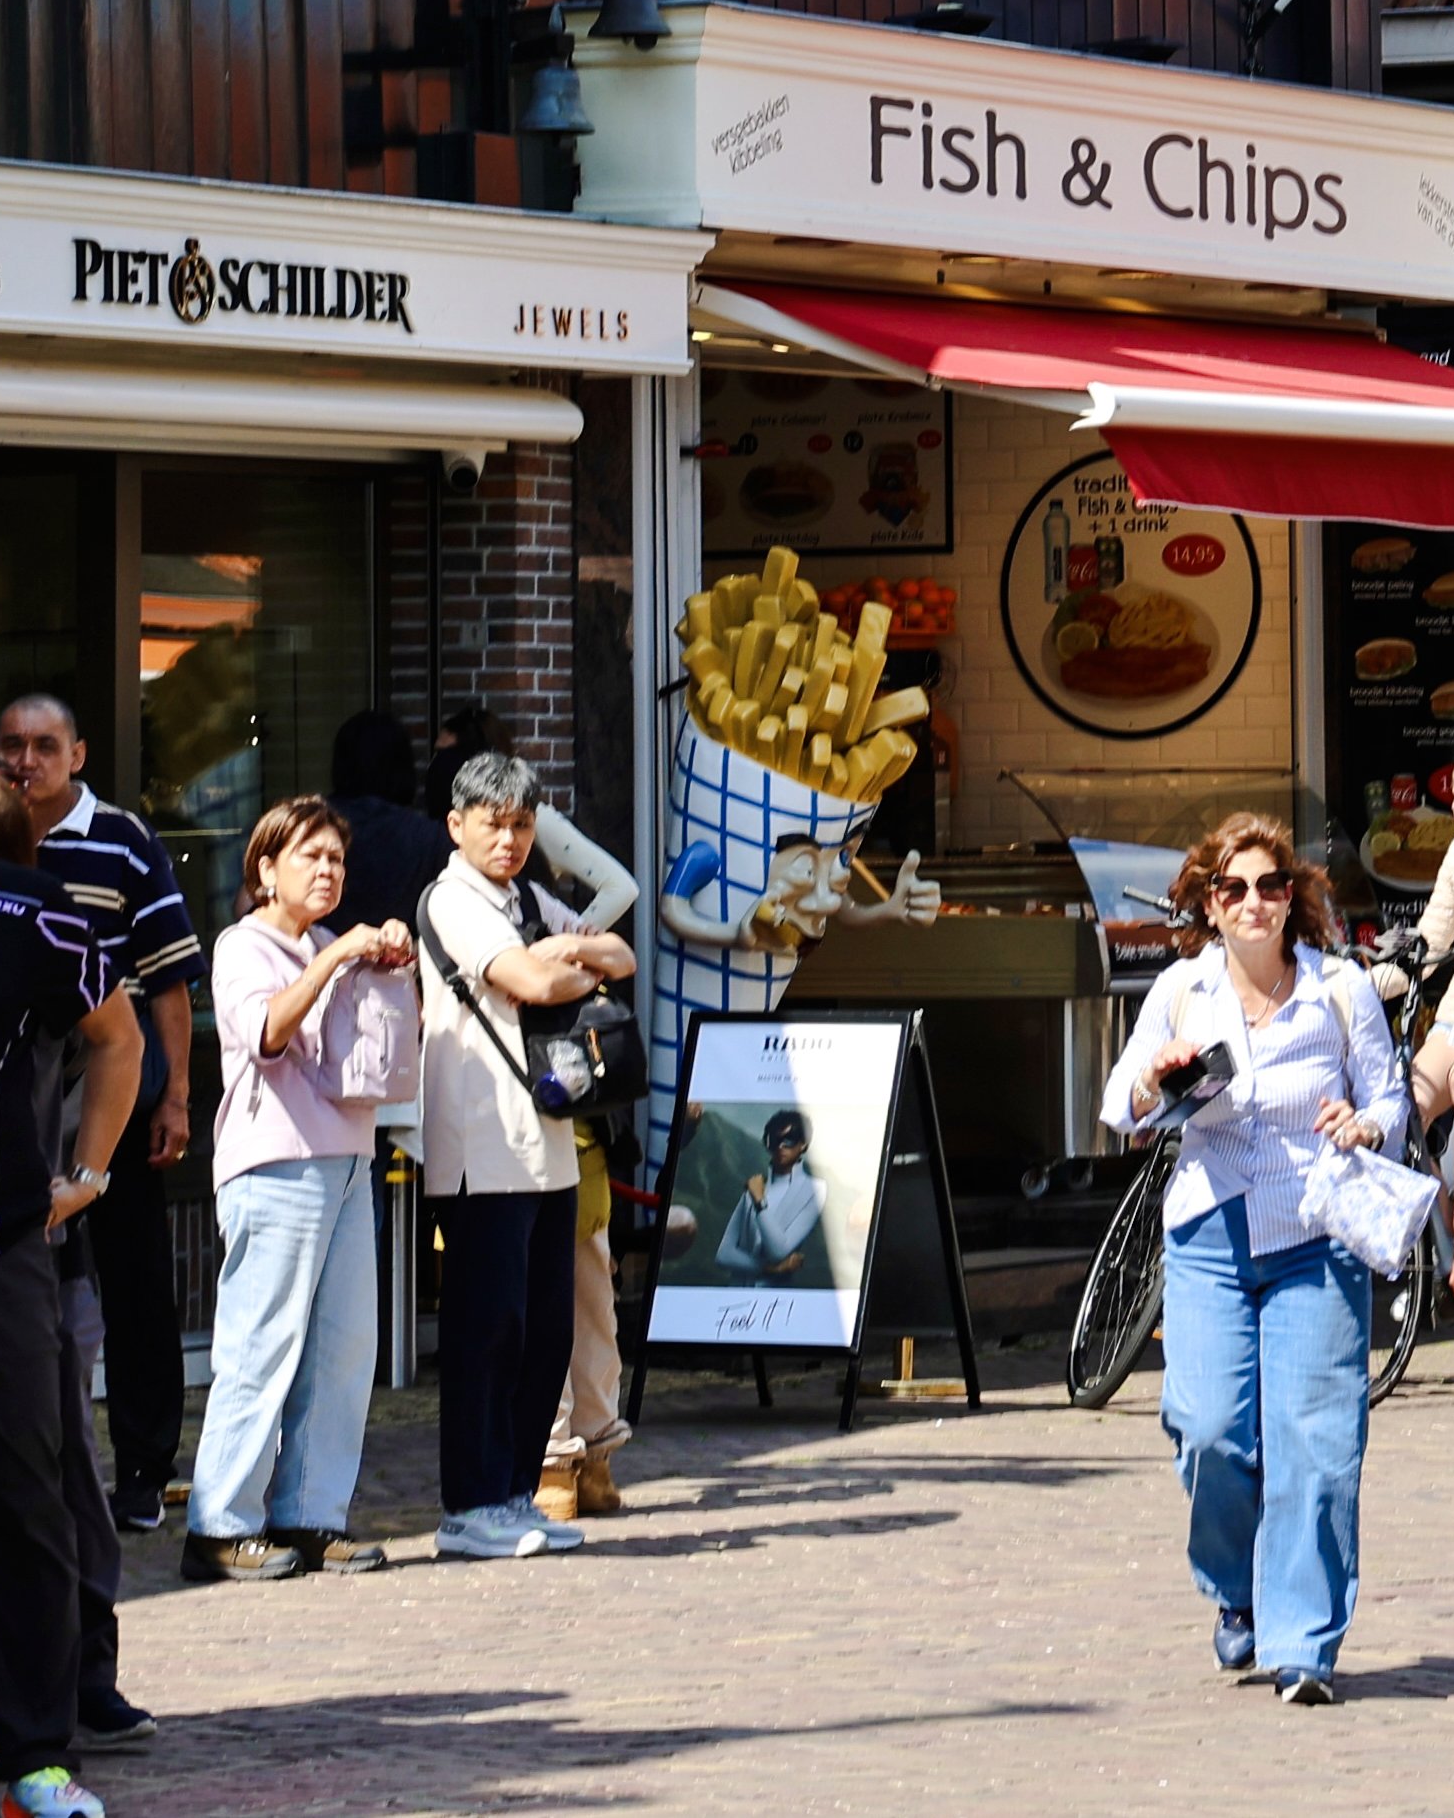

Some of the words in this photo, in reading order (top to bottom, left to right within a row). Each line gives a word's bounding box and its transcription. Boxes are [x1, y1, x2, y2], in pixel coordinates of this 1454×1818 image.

[711, 94, 790, 156] versgebakken
[869, 95, 1027, 200] Fish
[1061, 138, 1113, 210] &
[1144, 134, 1348, 239] Chips
[72, 238, 169, 304] PIET
[217, 256, 414, 333] SCHILDER
[514, 301, 629, 340] JEWELS
[1078, 497, 1109, 516] Fish
[1114, 499, 1126, 515] &
[1089, 520, 1100, 532] +
[1123, 517, 1170, 533] drink
[1172, 544, 1215, 565] 14,95
[763, 1035, 832, 1052] RADO
[716, 1300, 758, 1340] Feel
